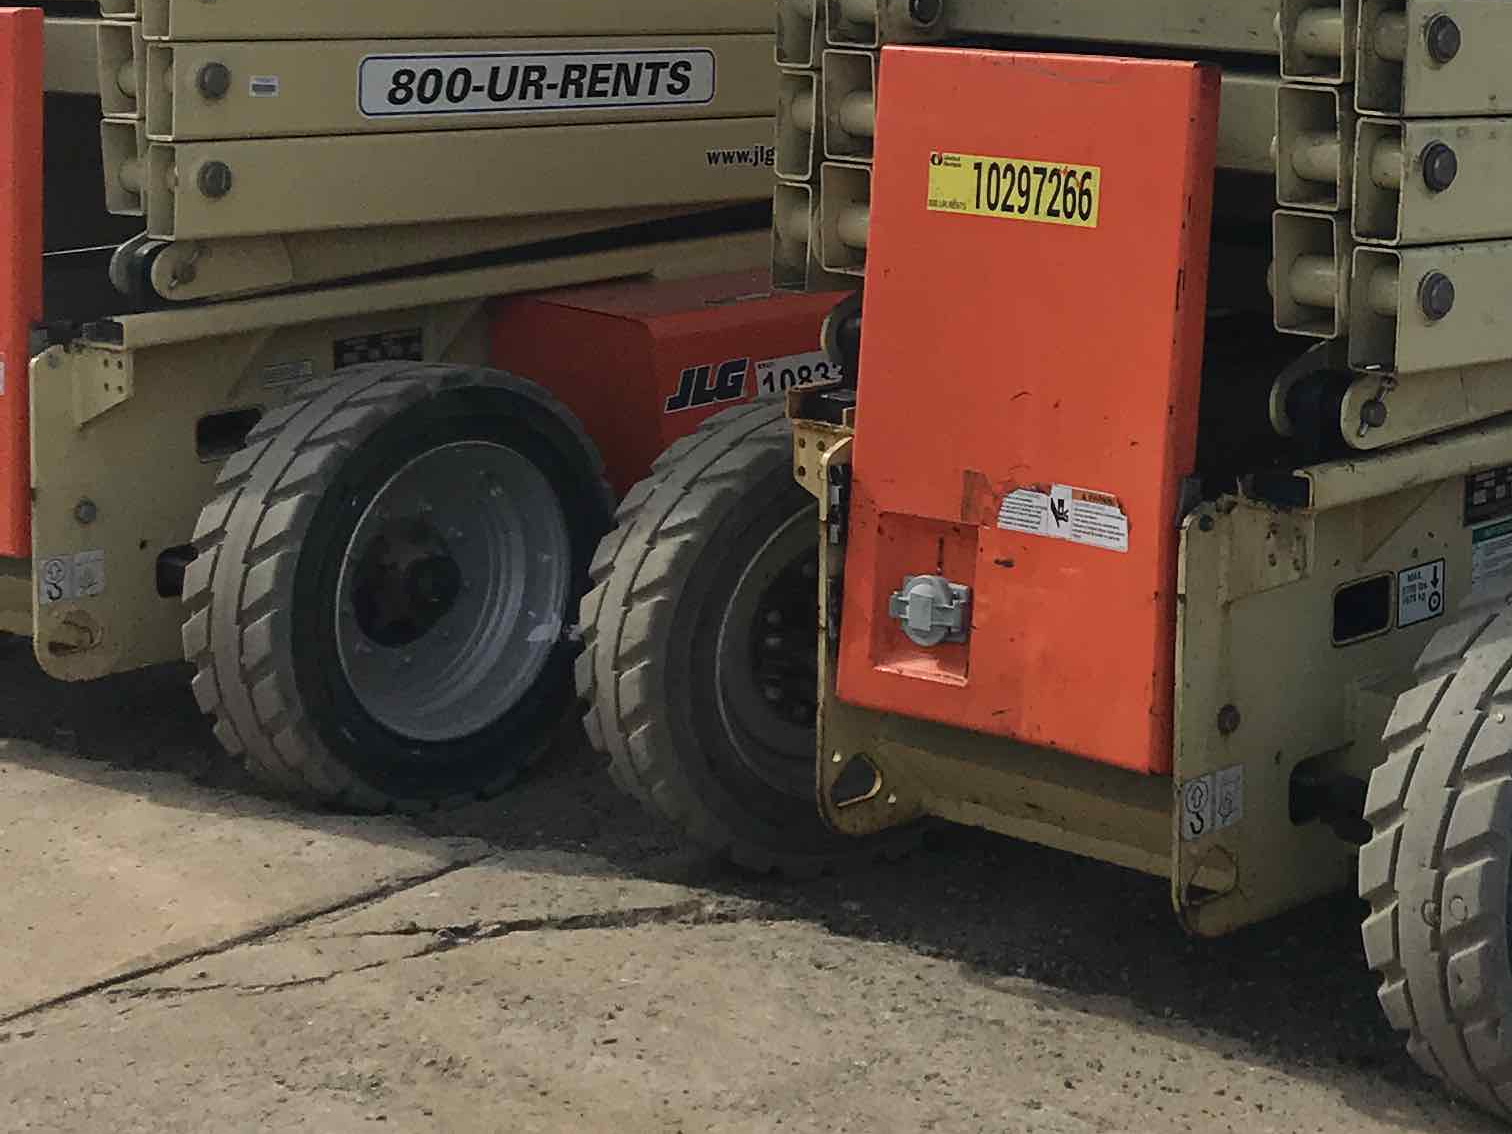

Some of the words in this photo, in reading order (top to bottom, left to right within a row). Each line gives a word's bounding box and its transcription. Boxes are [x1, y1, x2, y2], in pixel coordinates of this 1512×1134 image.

[387, 61, 692, 104] 800-UR-RENTS
[973, 162, 1093, 221] 10297266
[664, 358, 749, 414] JLG
